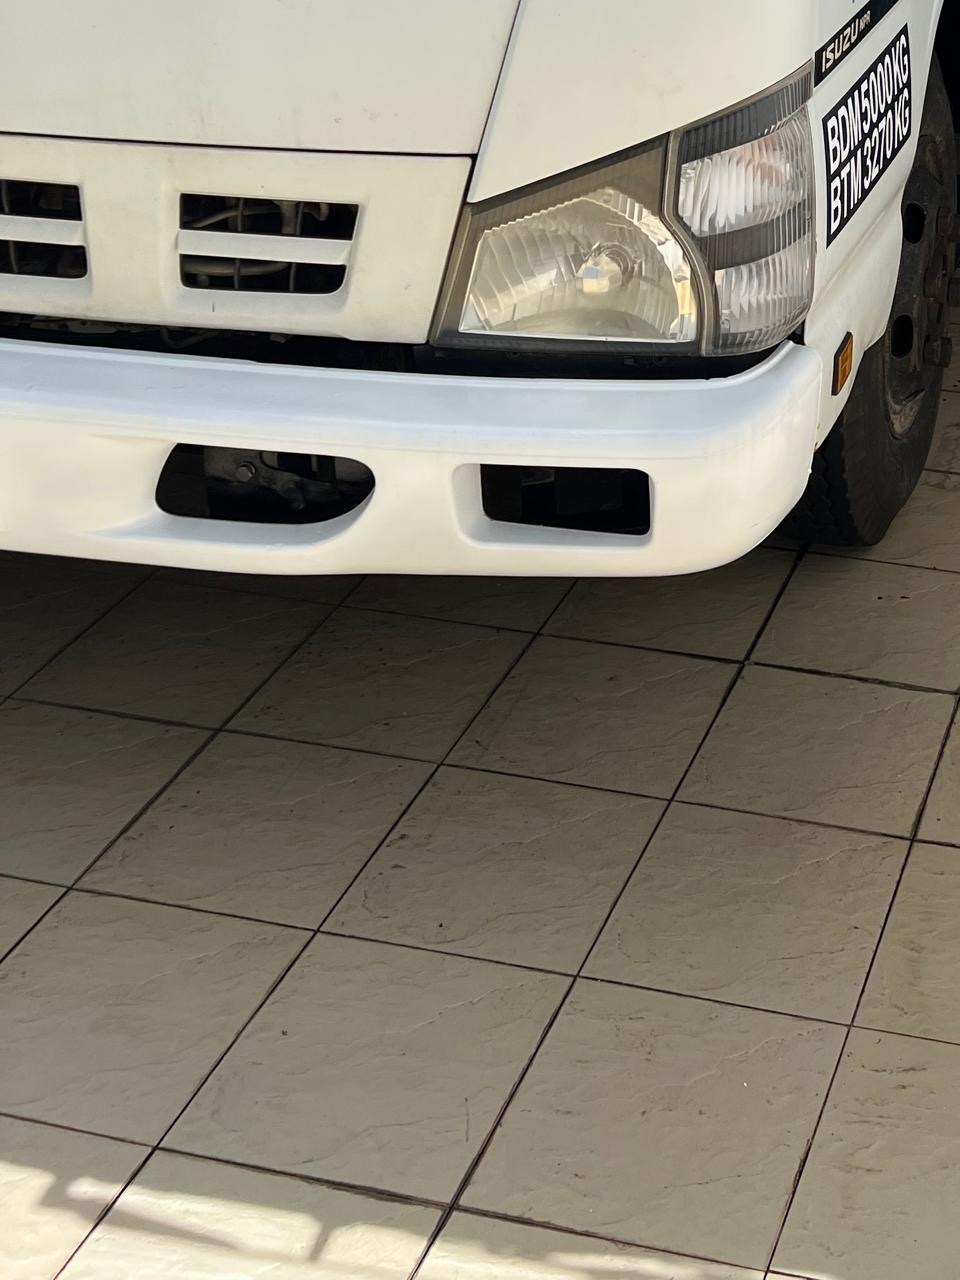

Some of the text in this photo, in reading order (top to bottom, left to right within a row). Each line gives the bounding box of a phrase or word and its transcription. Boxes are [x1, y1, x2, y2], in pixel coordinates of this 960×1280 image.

[822, 18, 859, 73] ISUZU
[827, 89, 862, 176] BDM
[830, 87, 910, 236] BTM 3270 KG
